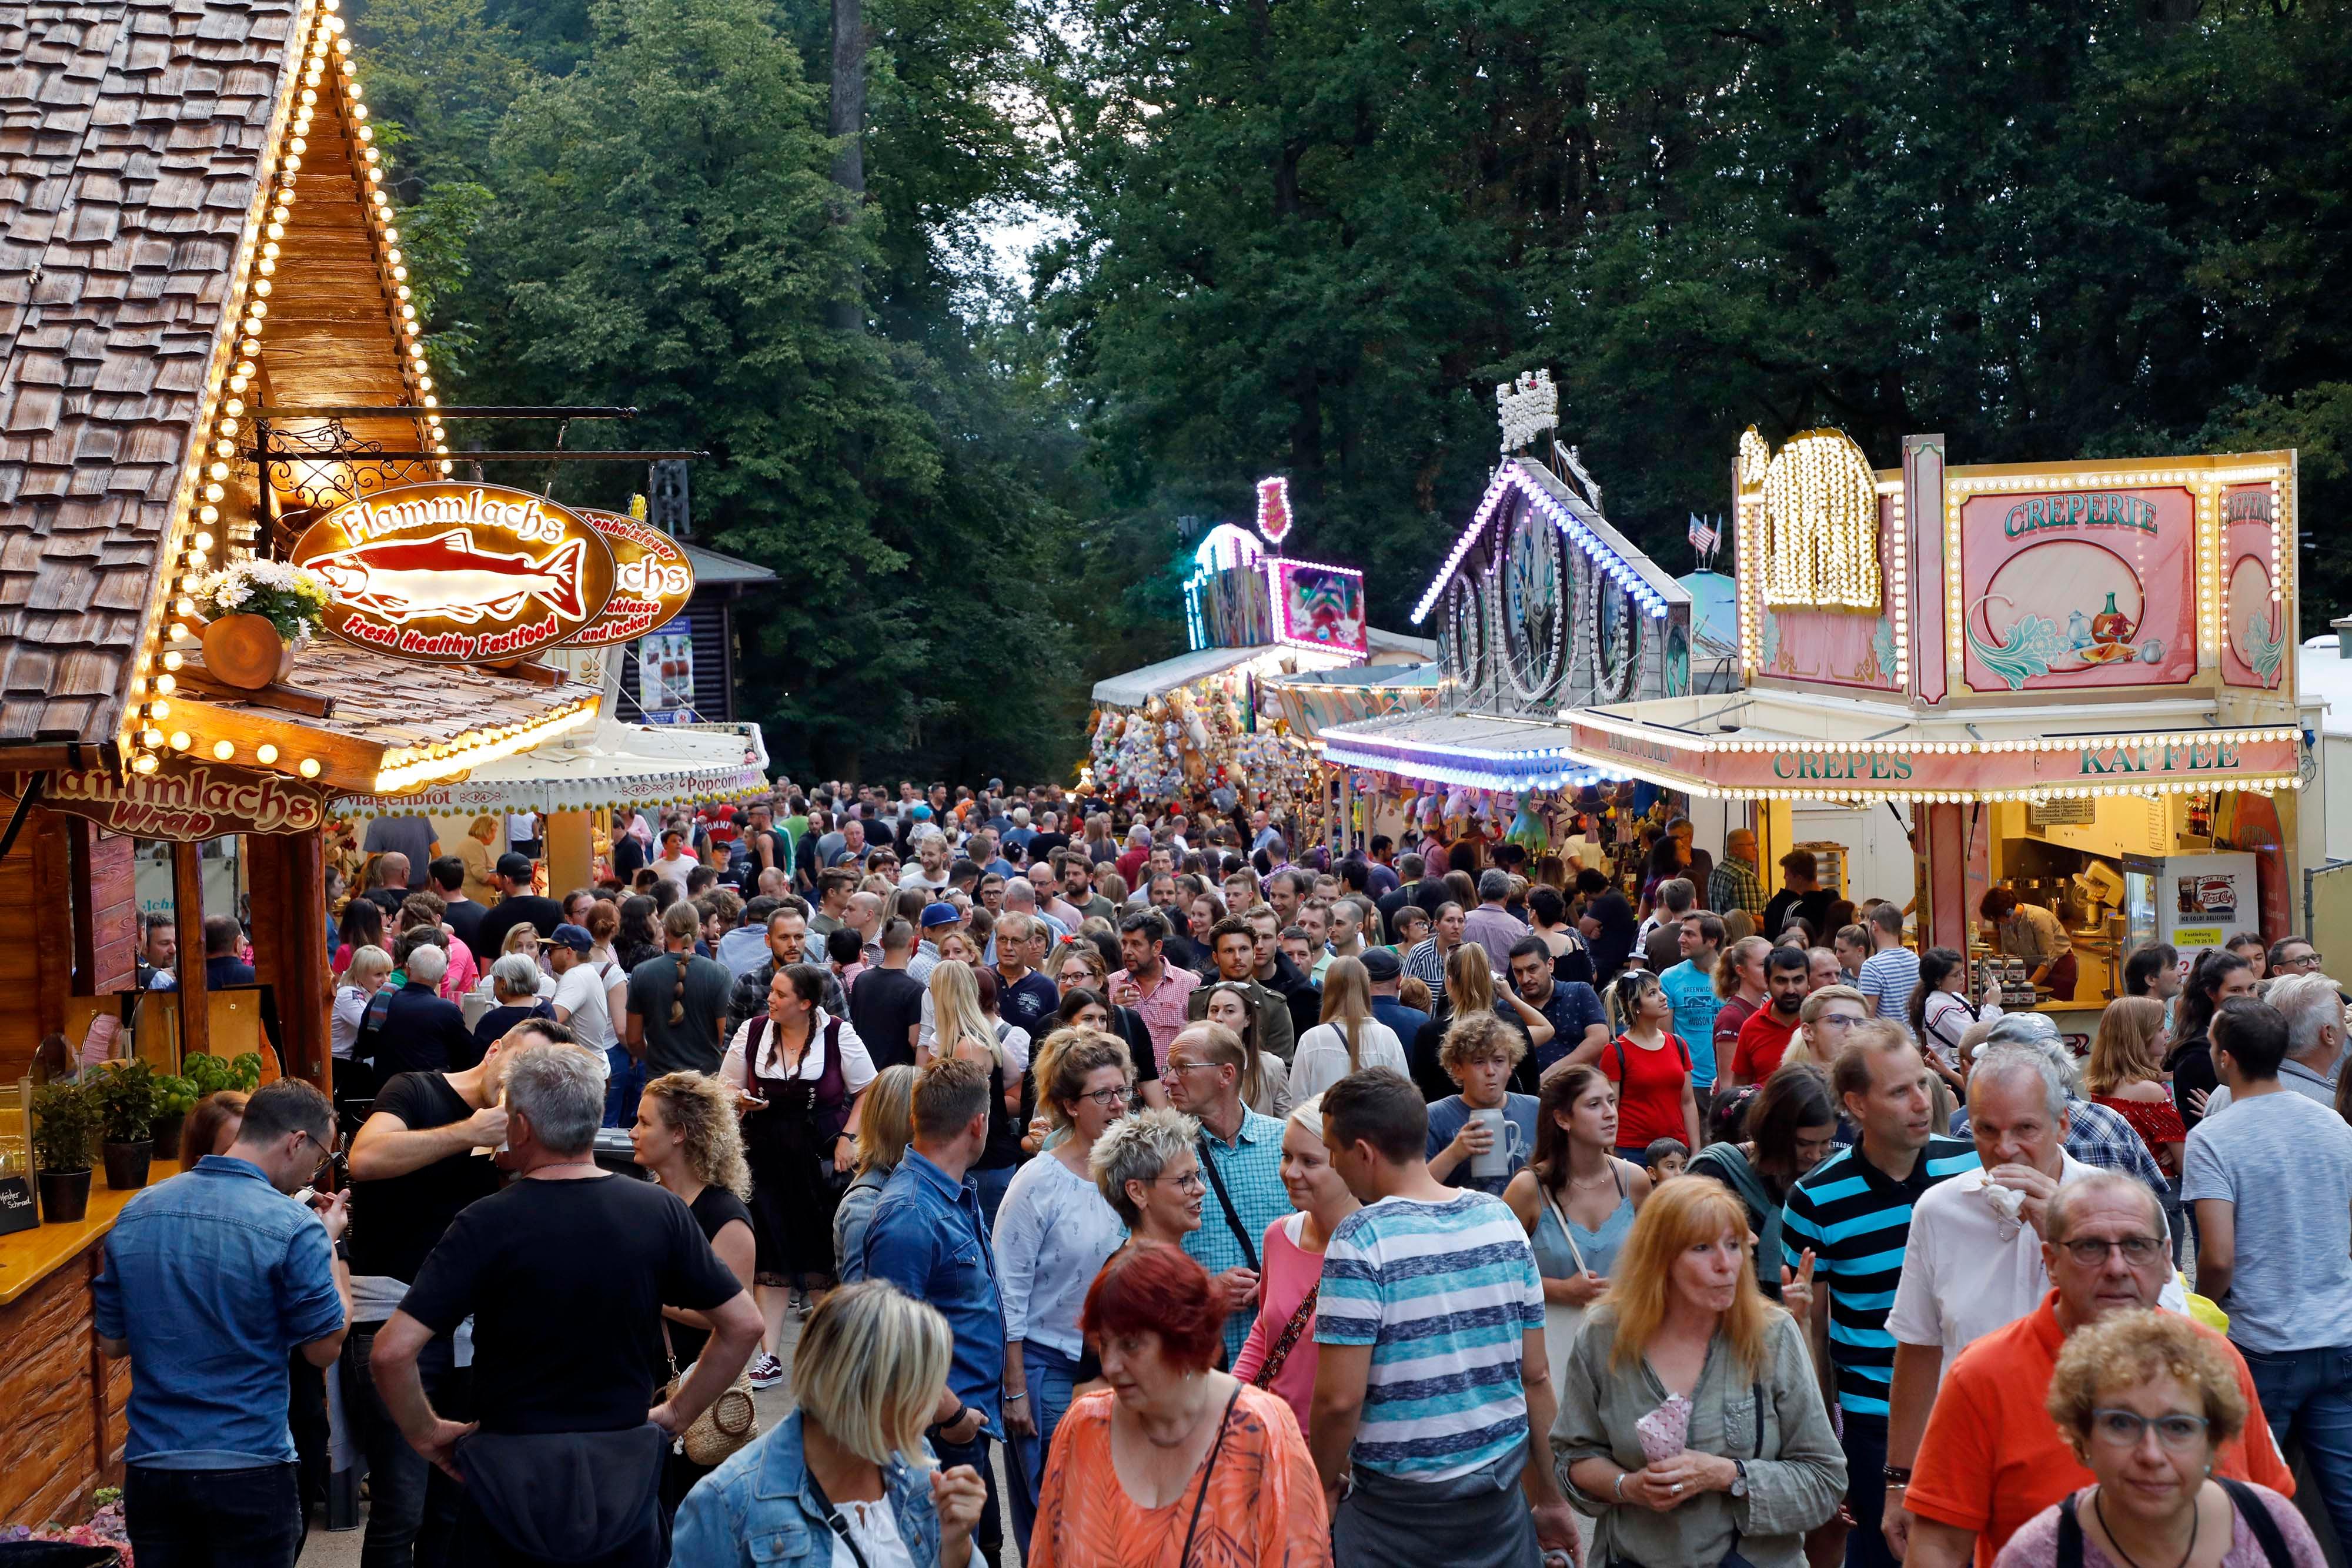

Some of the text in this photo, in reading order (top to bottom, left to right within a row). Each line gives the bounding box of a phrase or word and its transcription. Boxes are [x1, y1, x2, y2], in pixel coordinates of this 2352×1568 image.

[332, 489, 565, 544] Flammlachs
[2004, 493, 2158, 537] CREPERIE
[2221, 491, 2272, 525] REPERI
[586, 514, 677, 560] enholzfeuer
[617, 553, 690, 601] chs
[603, 597, 661, 616] aklasse
[343, 613, 558, 659] Fresh Healthy Fastfood
[580, 623, 609, 643] und
[610, 614, 652, 636] lecker
[1773, 752, 1913, 780] CREPES
[2078, 741, 2240, 774] KAFFEE
[682, 775, 737, 794] Popcorn
[109, 800, 215, 841] Wrap
[705, 820, 730, 832] TOMMY
[1688, 1016, 1710, 1026] HUDSON
